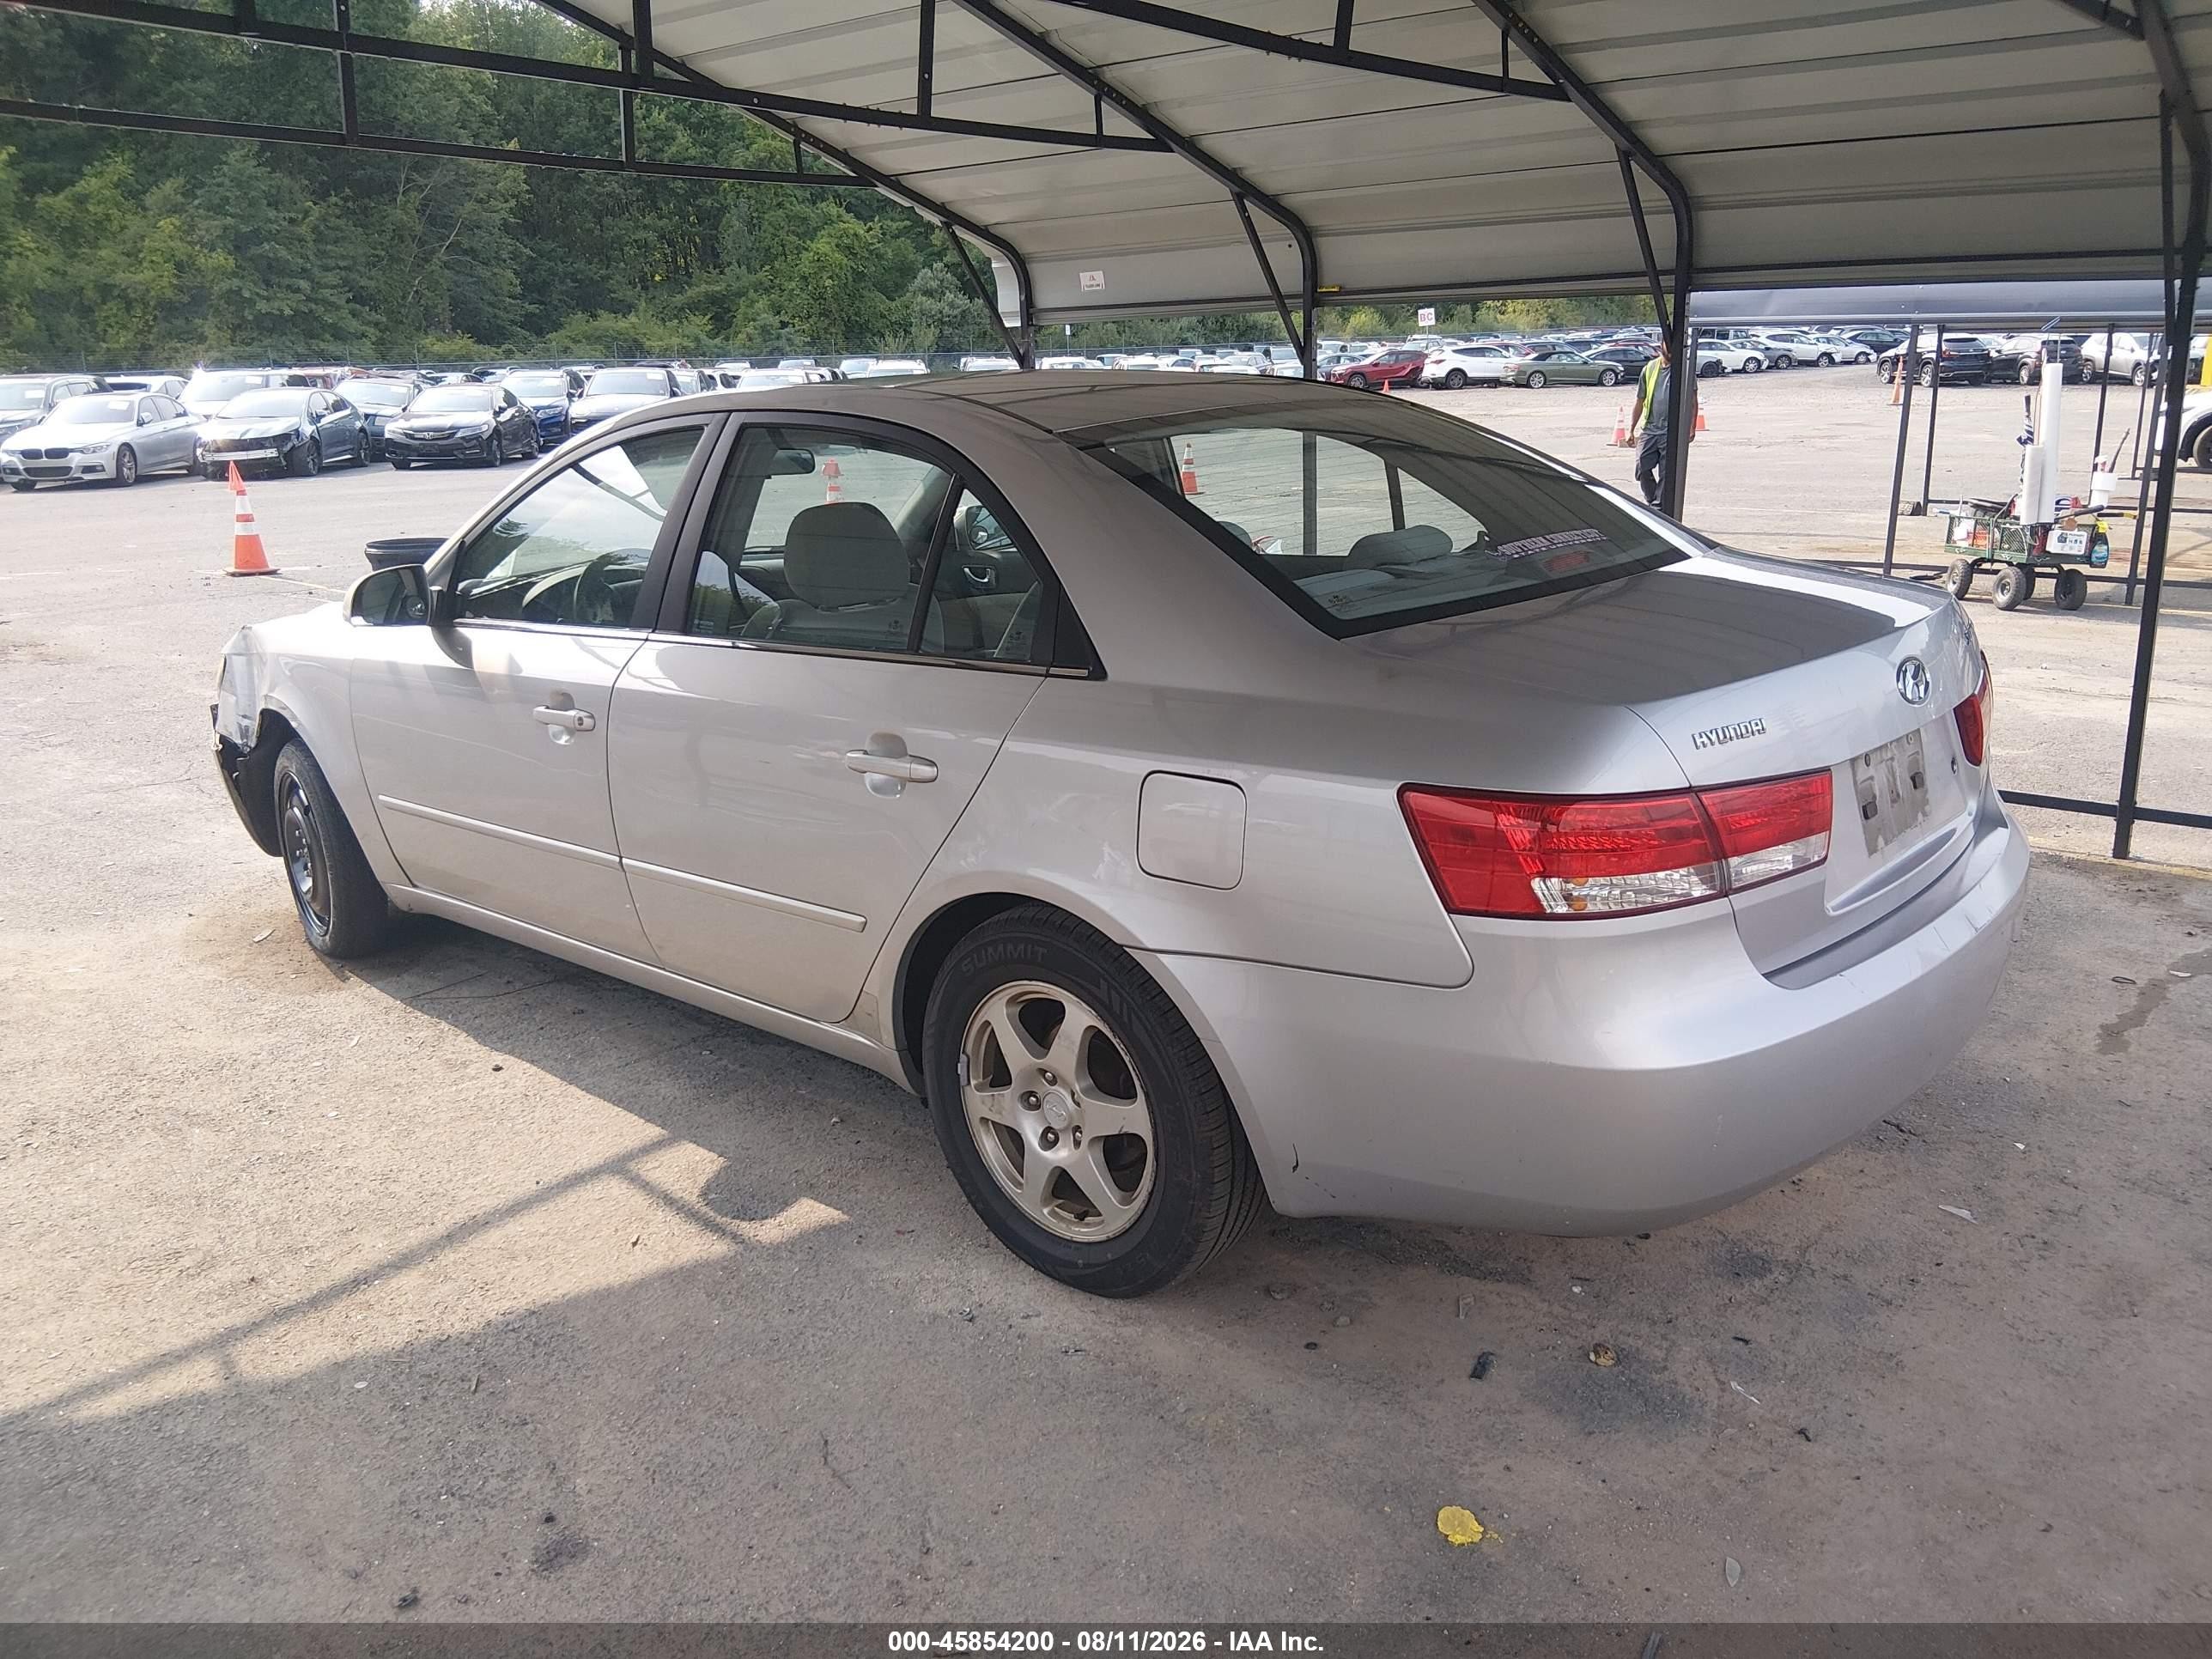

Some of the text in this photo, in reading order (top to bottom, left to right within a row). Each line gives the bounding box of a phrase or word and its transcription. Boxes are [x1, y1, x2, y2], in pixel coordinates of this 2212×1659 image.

[1419, 313, 1433, 322] BC
[1692, 718, 1766, 750] HYUNDAI
[961, 944, 1047, 977] SUMMIT
